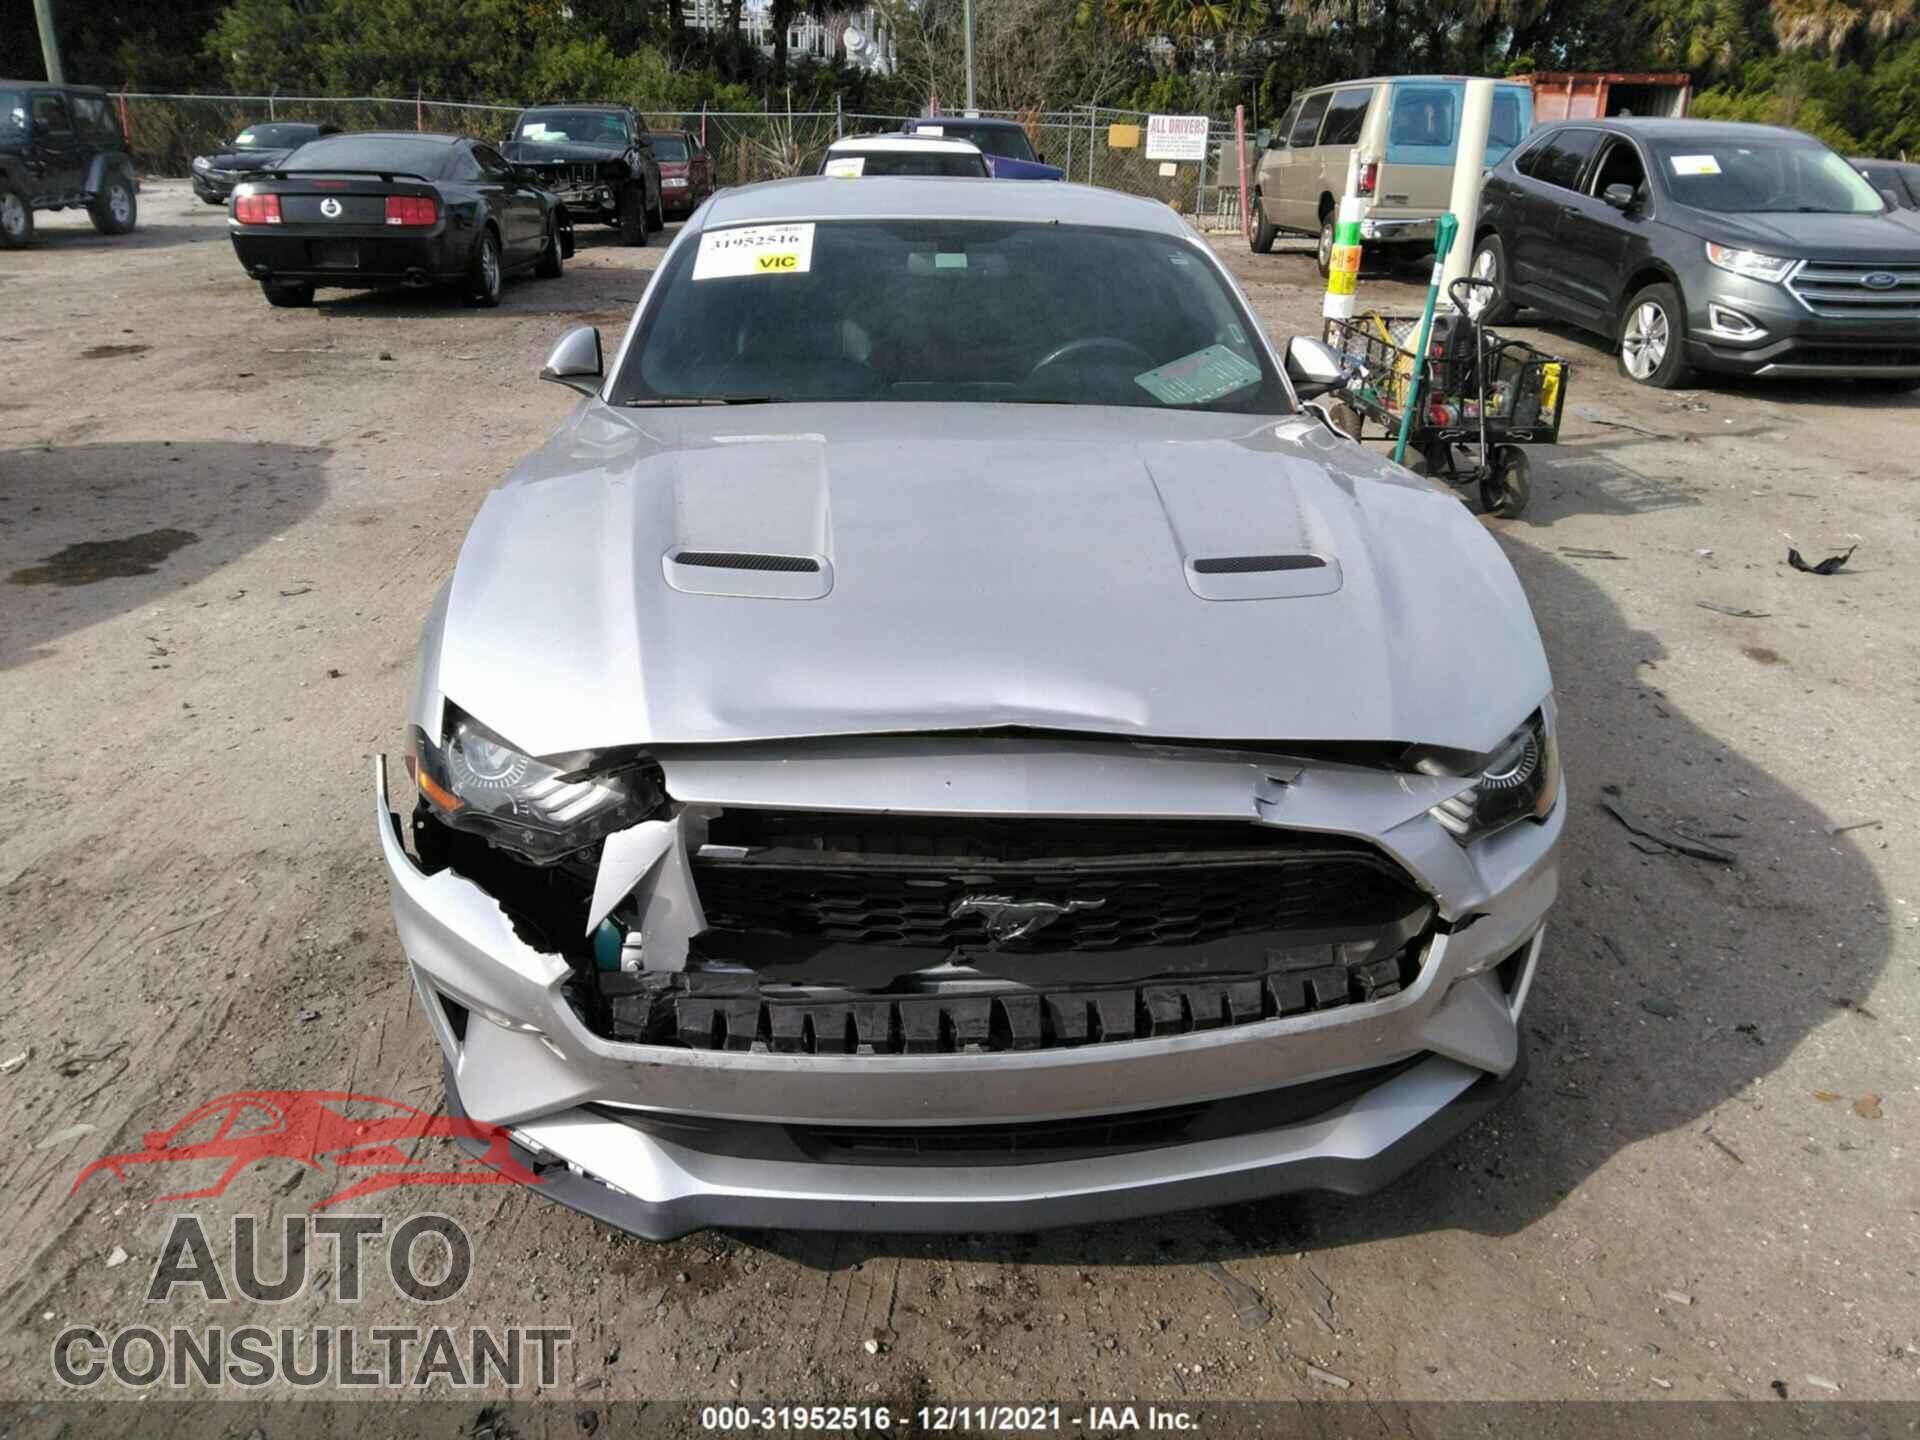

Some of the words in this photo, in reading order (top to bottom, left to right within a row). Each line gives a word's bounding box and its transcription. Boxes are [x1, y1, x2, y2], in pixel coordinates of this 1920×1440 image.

[1151, 118, 1167, 133] ALL
[1168, 118, 1206, 135] DRIVERS
[710, 234, 799, 250] 31952516
[759, 256, 796, 268] VIC
